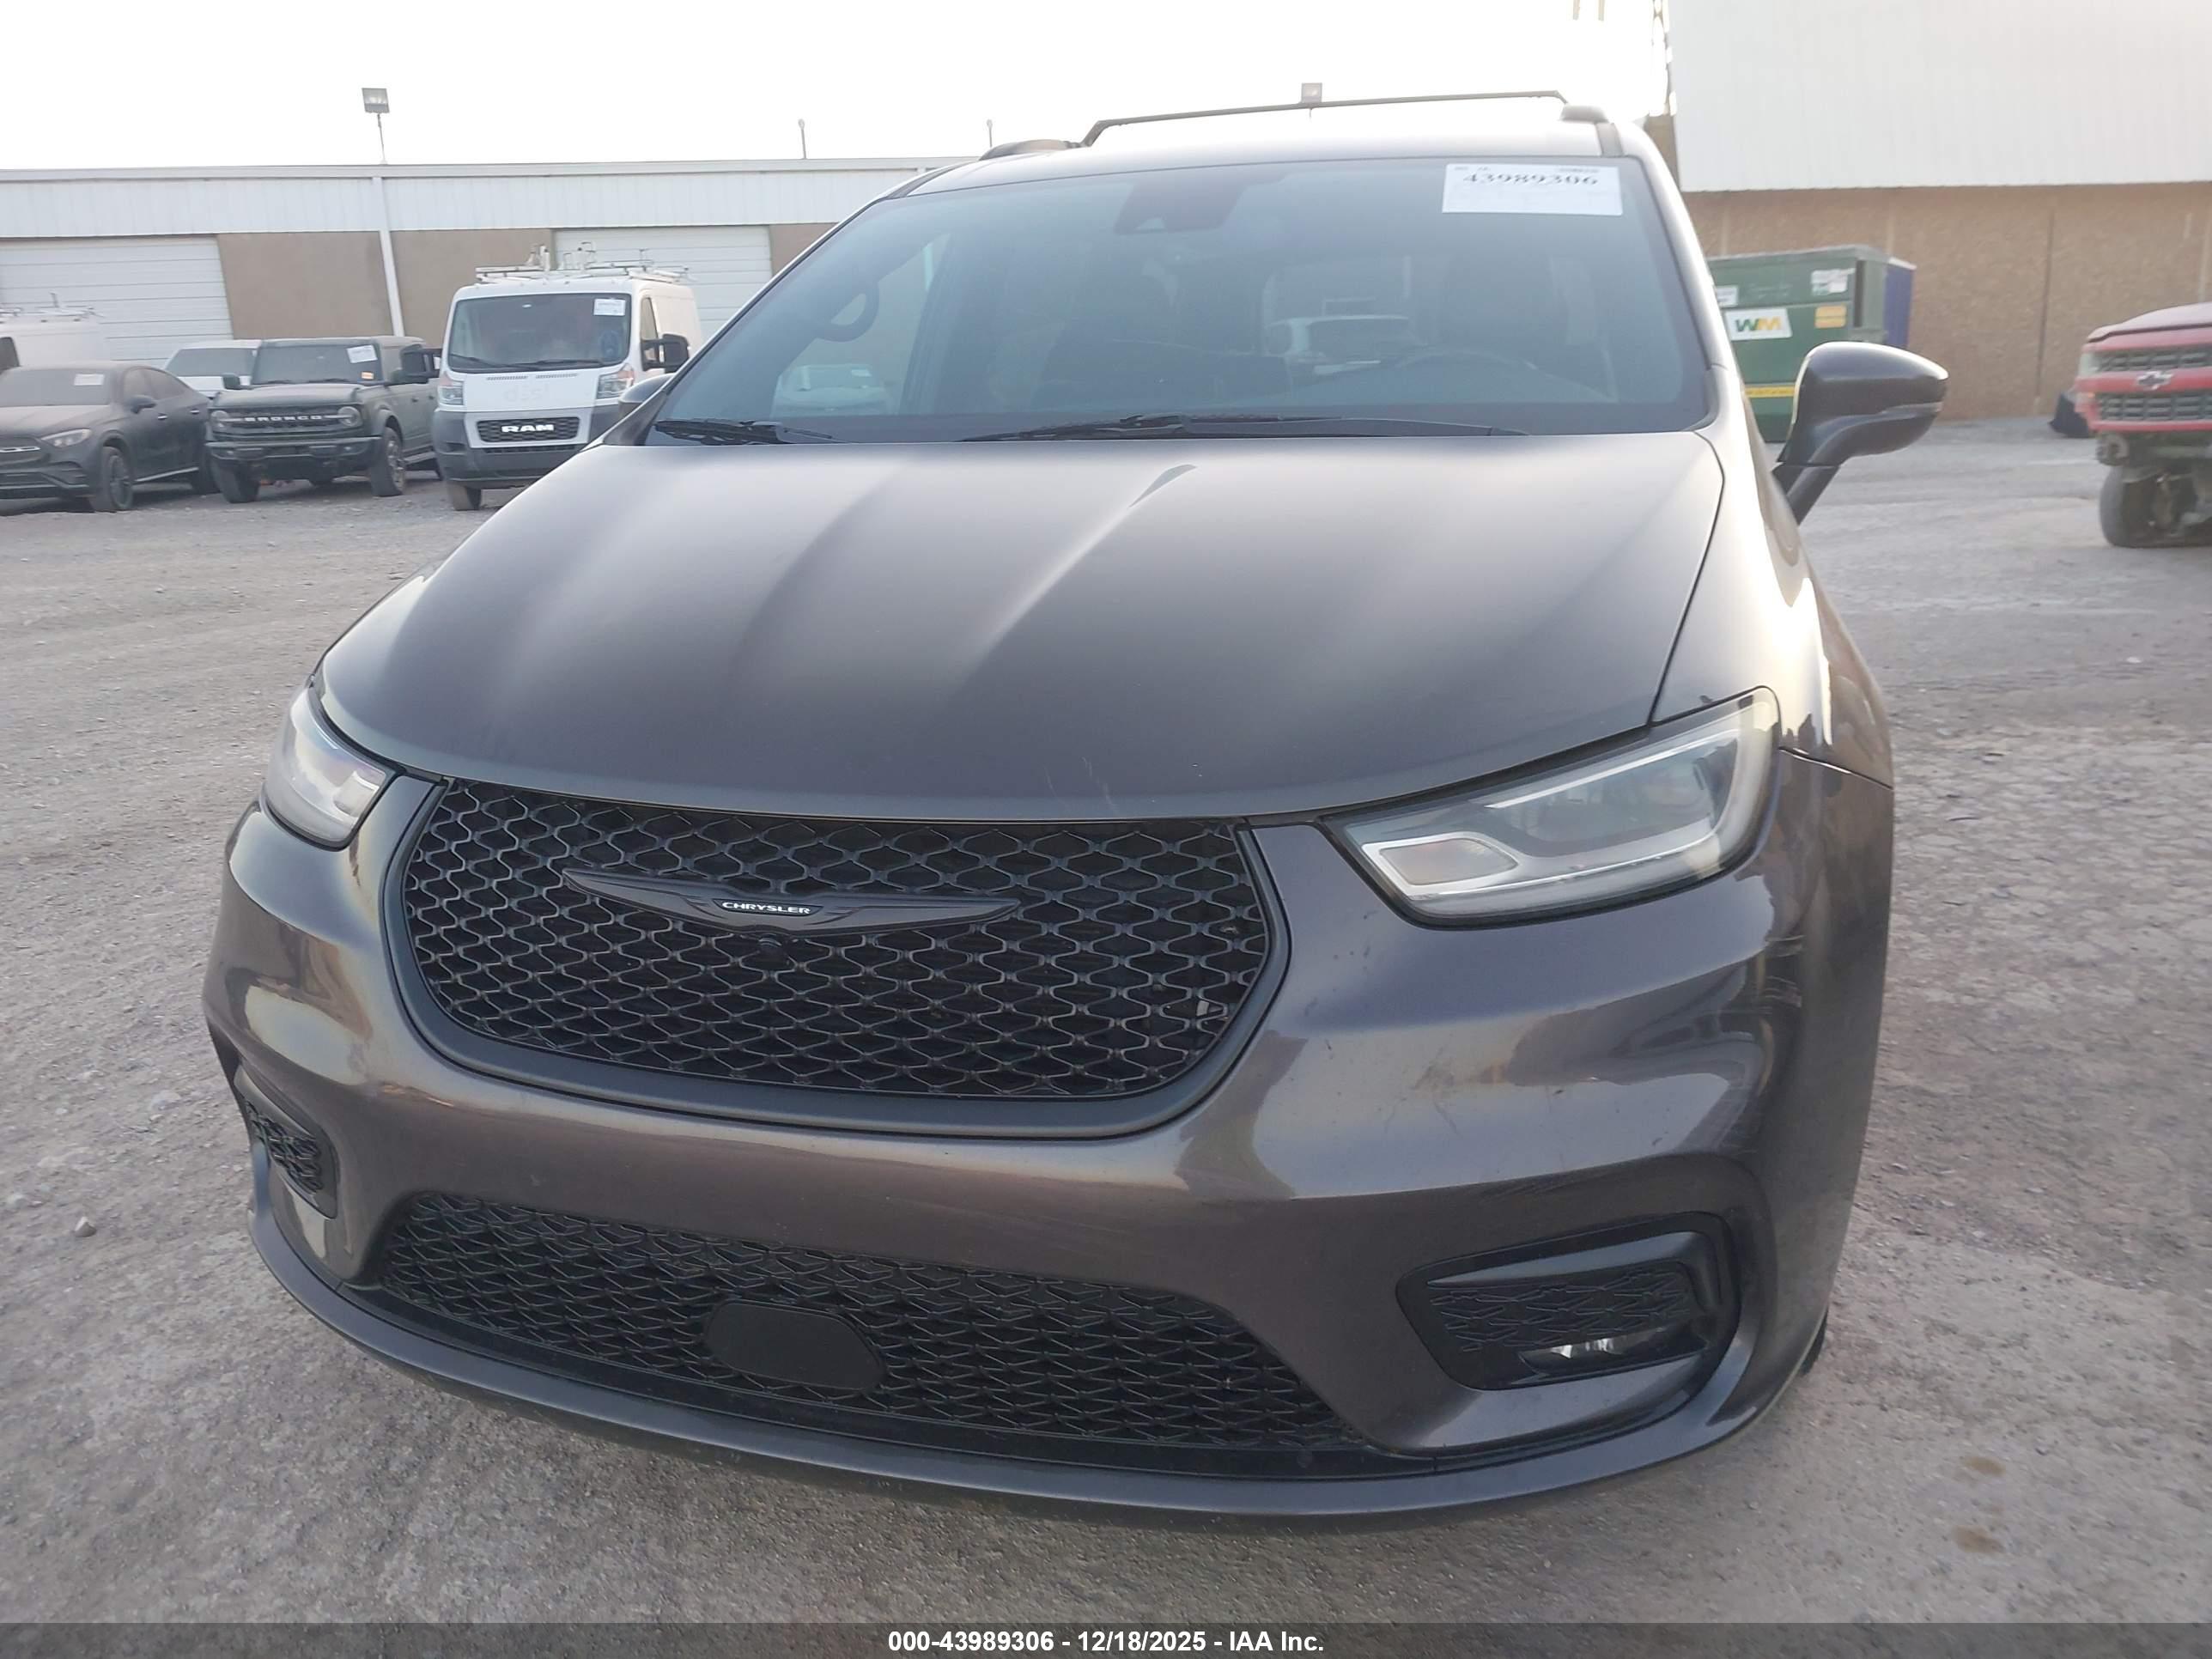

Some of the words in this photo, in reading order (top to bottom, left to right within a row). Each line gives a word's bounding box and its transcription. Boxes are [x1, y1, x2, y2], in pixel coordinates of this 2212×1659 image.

[1462, 172, 1598, 185] 43989306
[1735, 316, 1782, 332] WM
[501, 423, 554, 433] RAM
[722, 902, 811, 915] CHRYSLER
